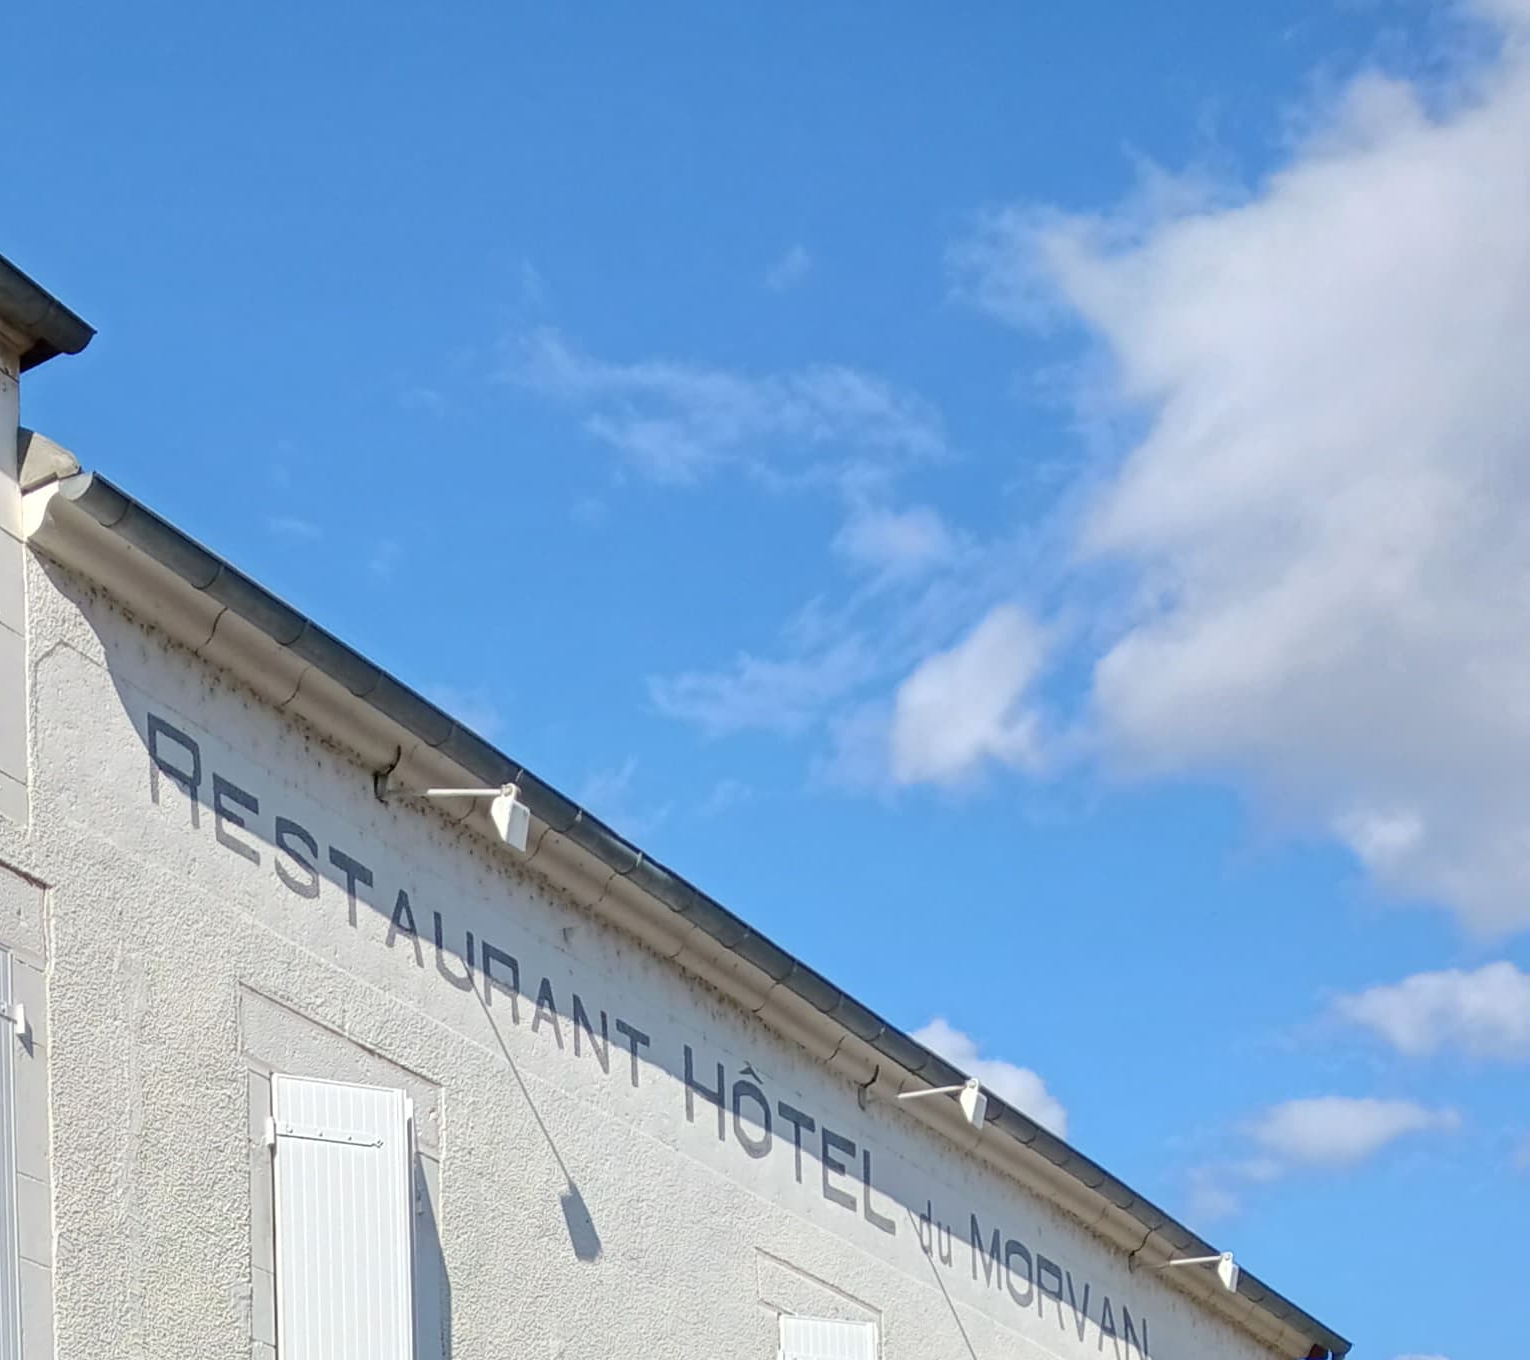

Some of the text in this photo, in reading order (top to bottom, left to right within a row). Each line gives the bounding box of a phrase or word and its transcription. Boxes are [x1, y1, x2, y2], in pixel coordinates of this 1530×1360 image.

[147, 712, 650, 1088] RESTAURANT
[683, 1044, 896, 1236] HÔTEL
[919, 1200, 953, 1268] du
